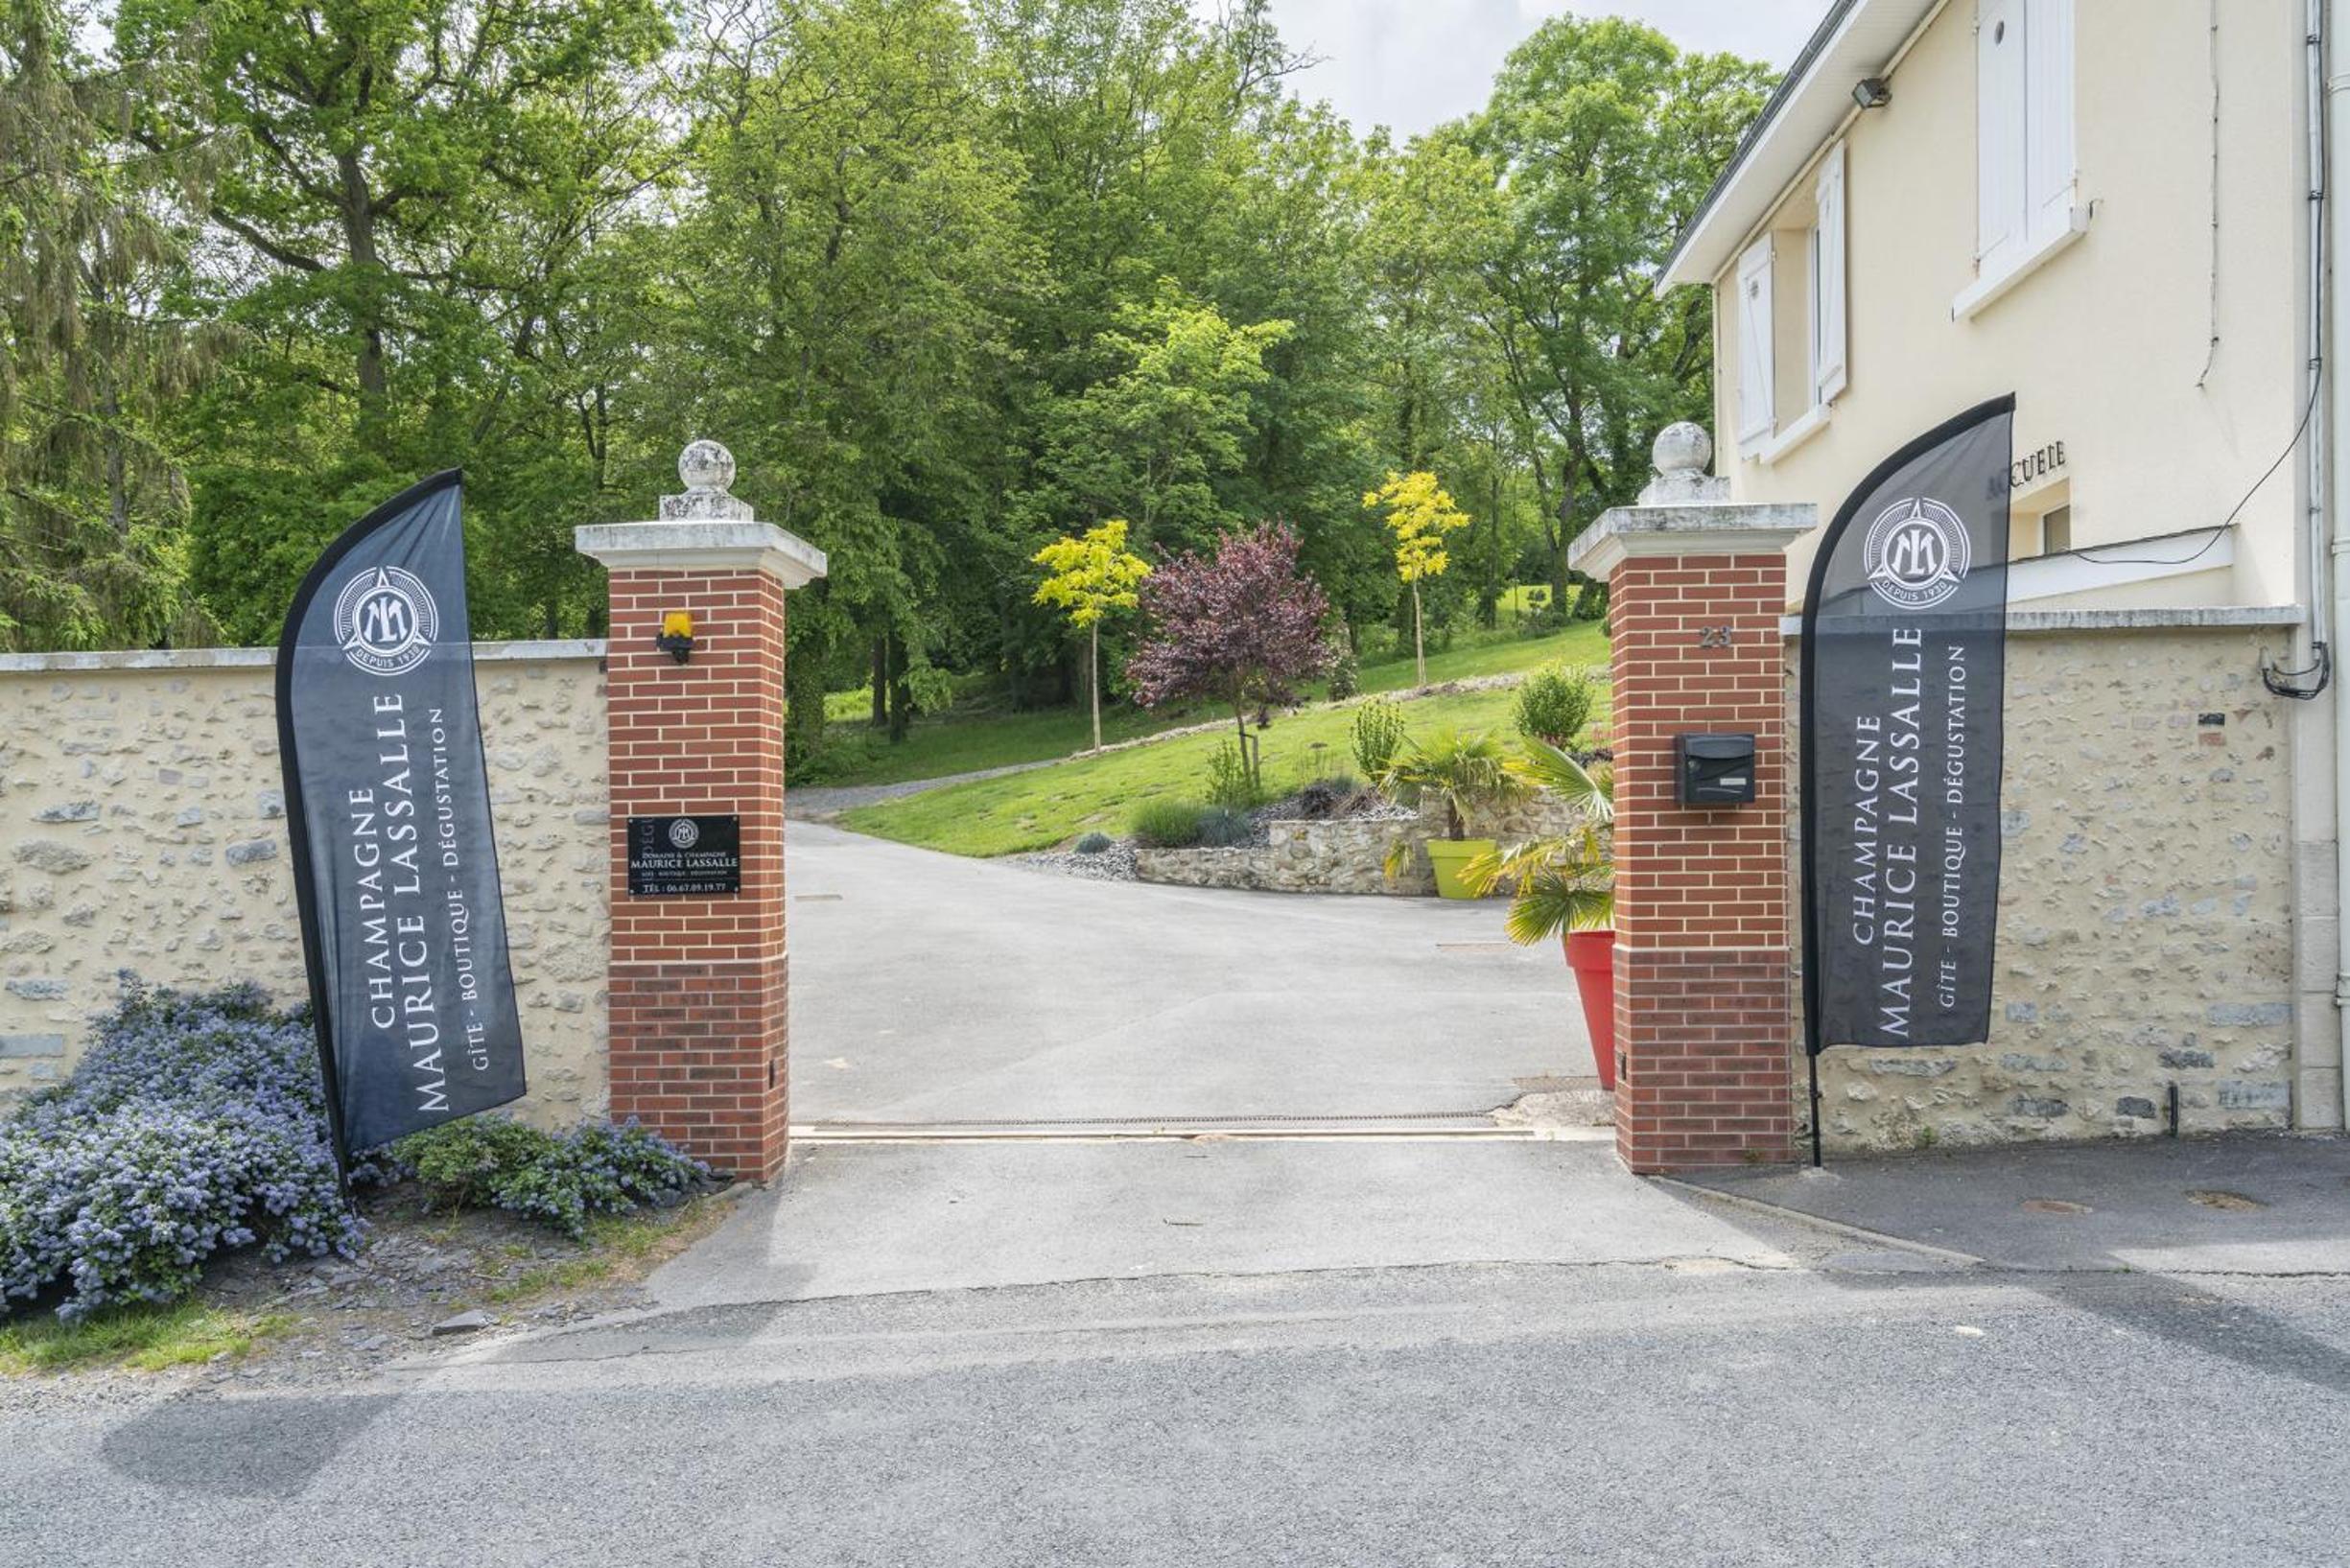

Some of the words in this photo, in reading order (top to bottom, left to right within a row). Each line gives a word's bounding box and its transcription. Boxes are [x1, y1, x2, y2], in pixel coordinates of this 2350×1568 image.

[356, 648, 394, 667] DEPUIS
[1700, 625, 1731, 648] 23
[1881, 579, 1918, 600] DEPUIS
[373, 693, 420, 896] LASSALLE
[429, 708, 459, 867] DÉGUSTATION
[1887, 627, 1922, 826] LASSALLE
[1943, 645, 1966, 805] DÉGUSTATION
[348, 787, 395, 1029] CHAMPAGNE
[631, 859, 683, 869] MAURICE
[686, 858, 739, 868] LASSALLE
[1852, 715, 1881, 945] CHAMPAGNE
[1942, 826, 1966, 938] BOUTIQUE
[397, 915, 450, 1112] MAURICE
[447, 888, 478, 1001] BOUTIQUE
[1879, 843, 1916, 1039] MAURICE
